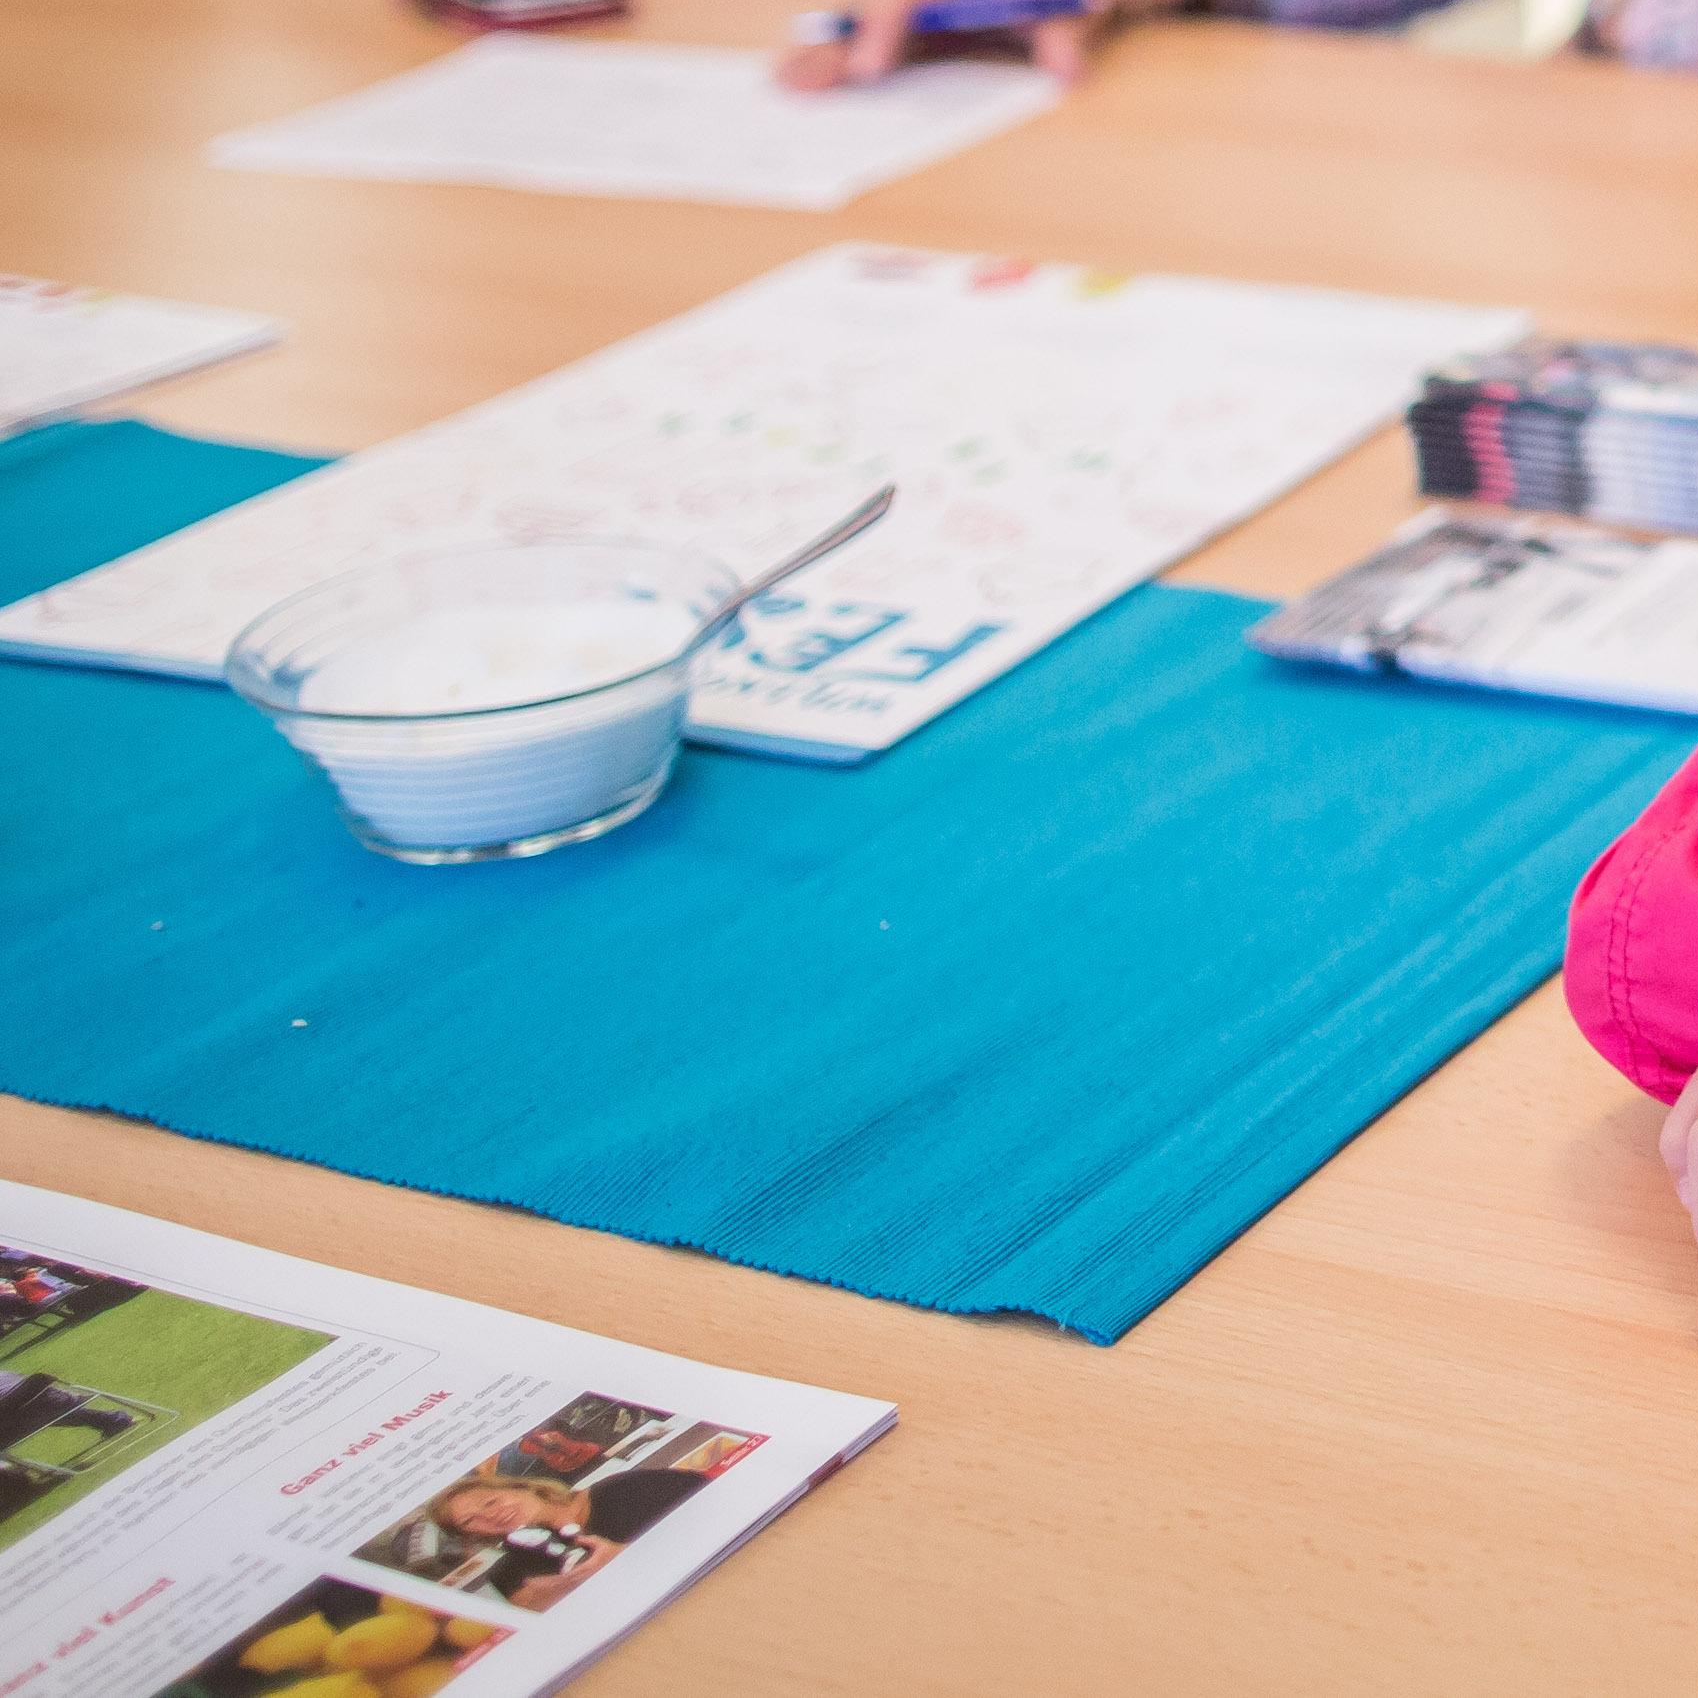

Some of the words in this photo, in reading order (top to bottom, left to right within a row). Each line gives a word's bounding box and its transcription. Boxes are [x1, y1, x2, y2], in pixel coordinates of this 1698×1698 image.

[281, 1458, 344, 1495] Ganz
[341, 1431, 386, 1456] viel
[381, 1390, 454, 1432] Musik
